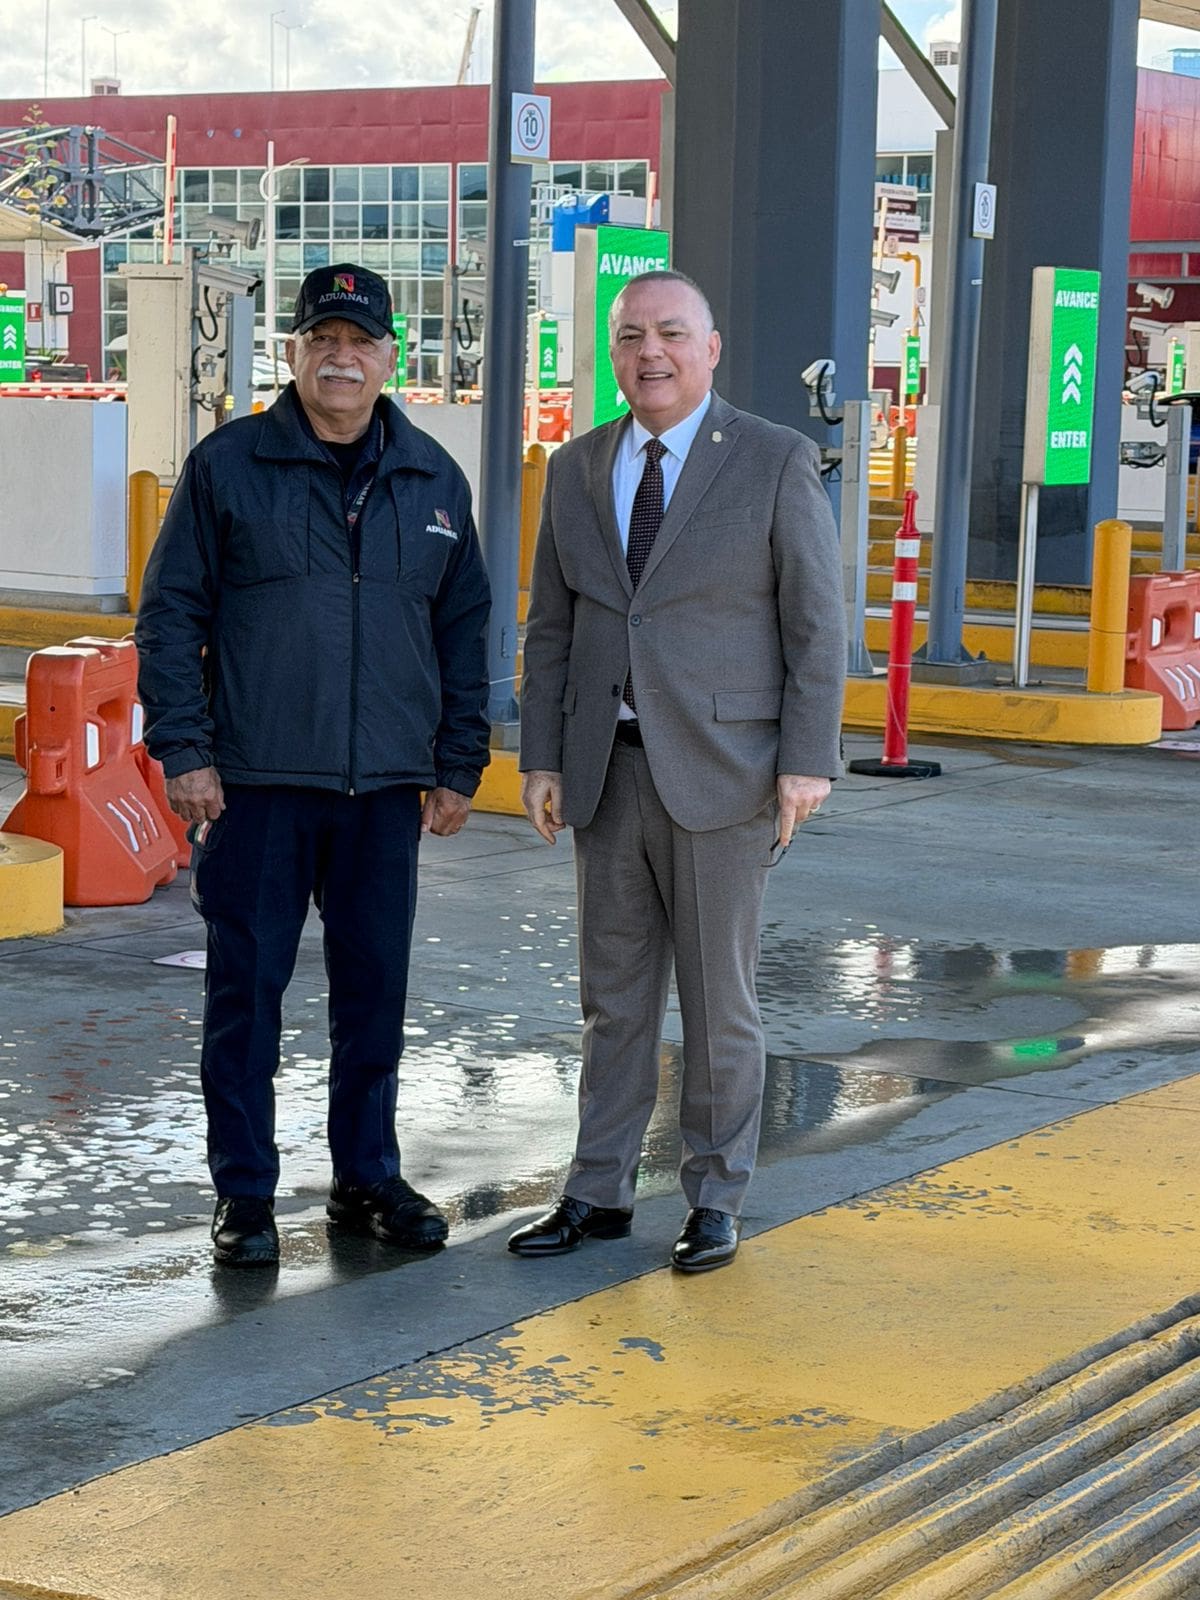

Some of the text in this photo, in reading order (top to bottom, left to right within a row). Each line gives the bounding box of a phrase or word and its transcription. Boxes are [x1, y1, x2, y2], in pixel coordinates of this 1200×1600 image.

[523, 116, 538, 137] 10
[600, 253, 666, 276] AVANCE
[60, 291, 69, 306] D
[319, 292, 369, 305] ADUANAS
[1055, 290, 1098, 309] AVANCE
[1050, 431, 1087, 449] ENTER
